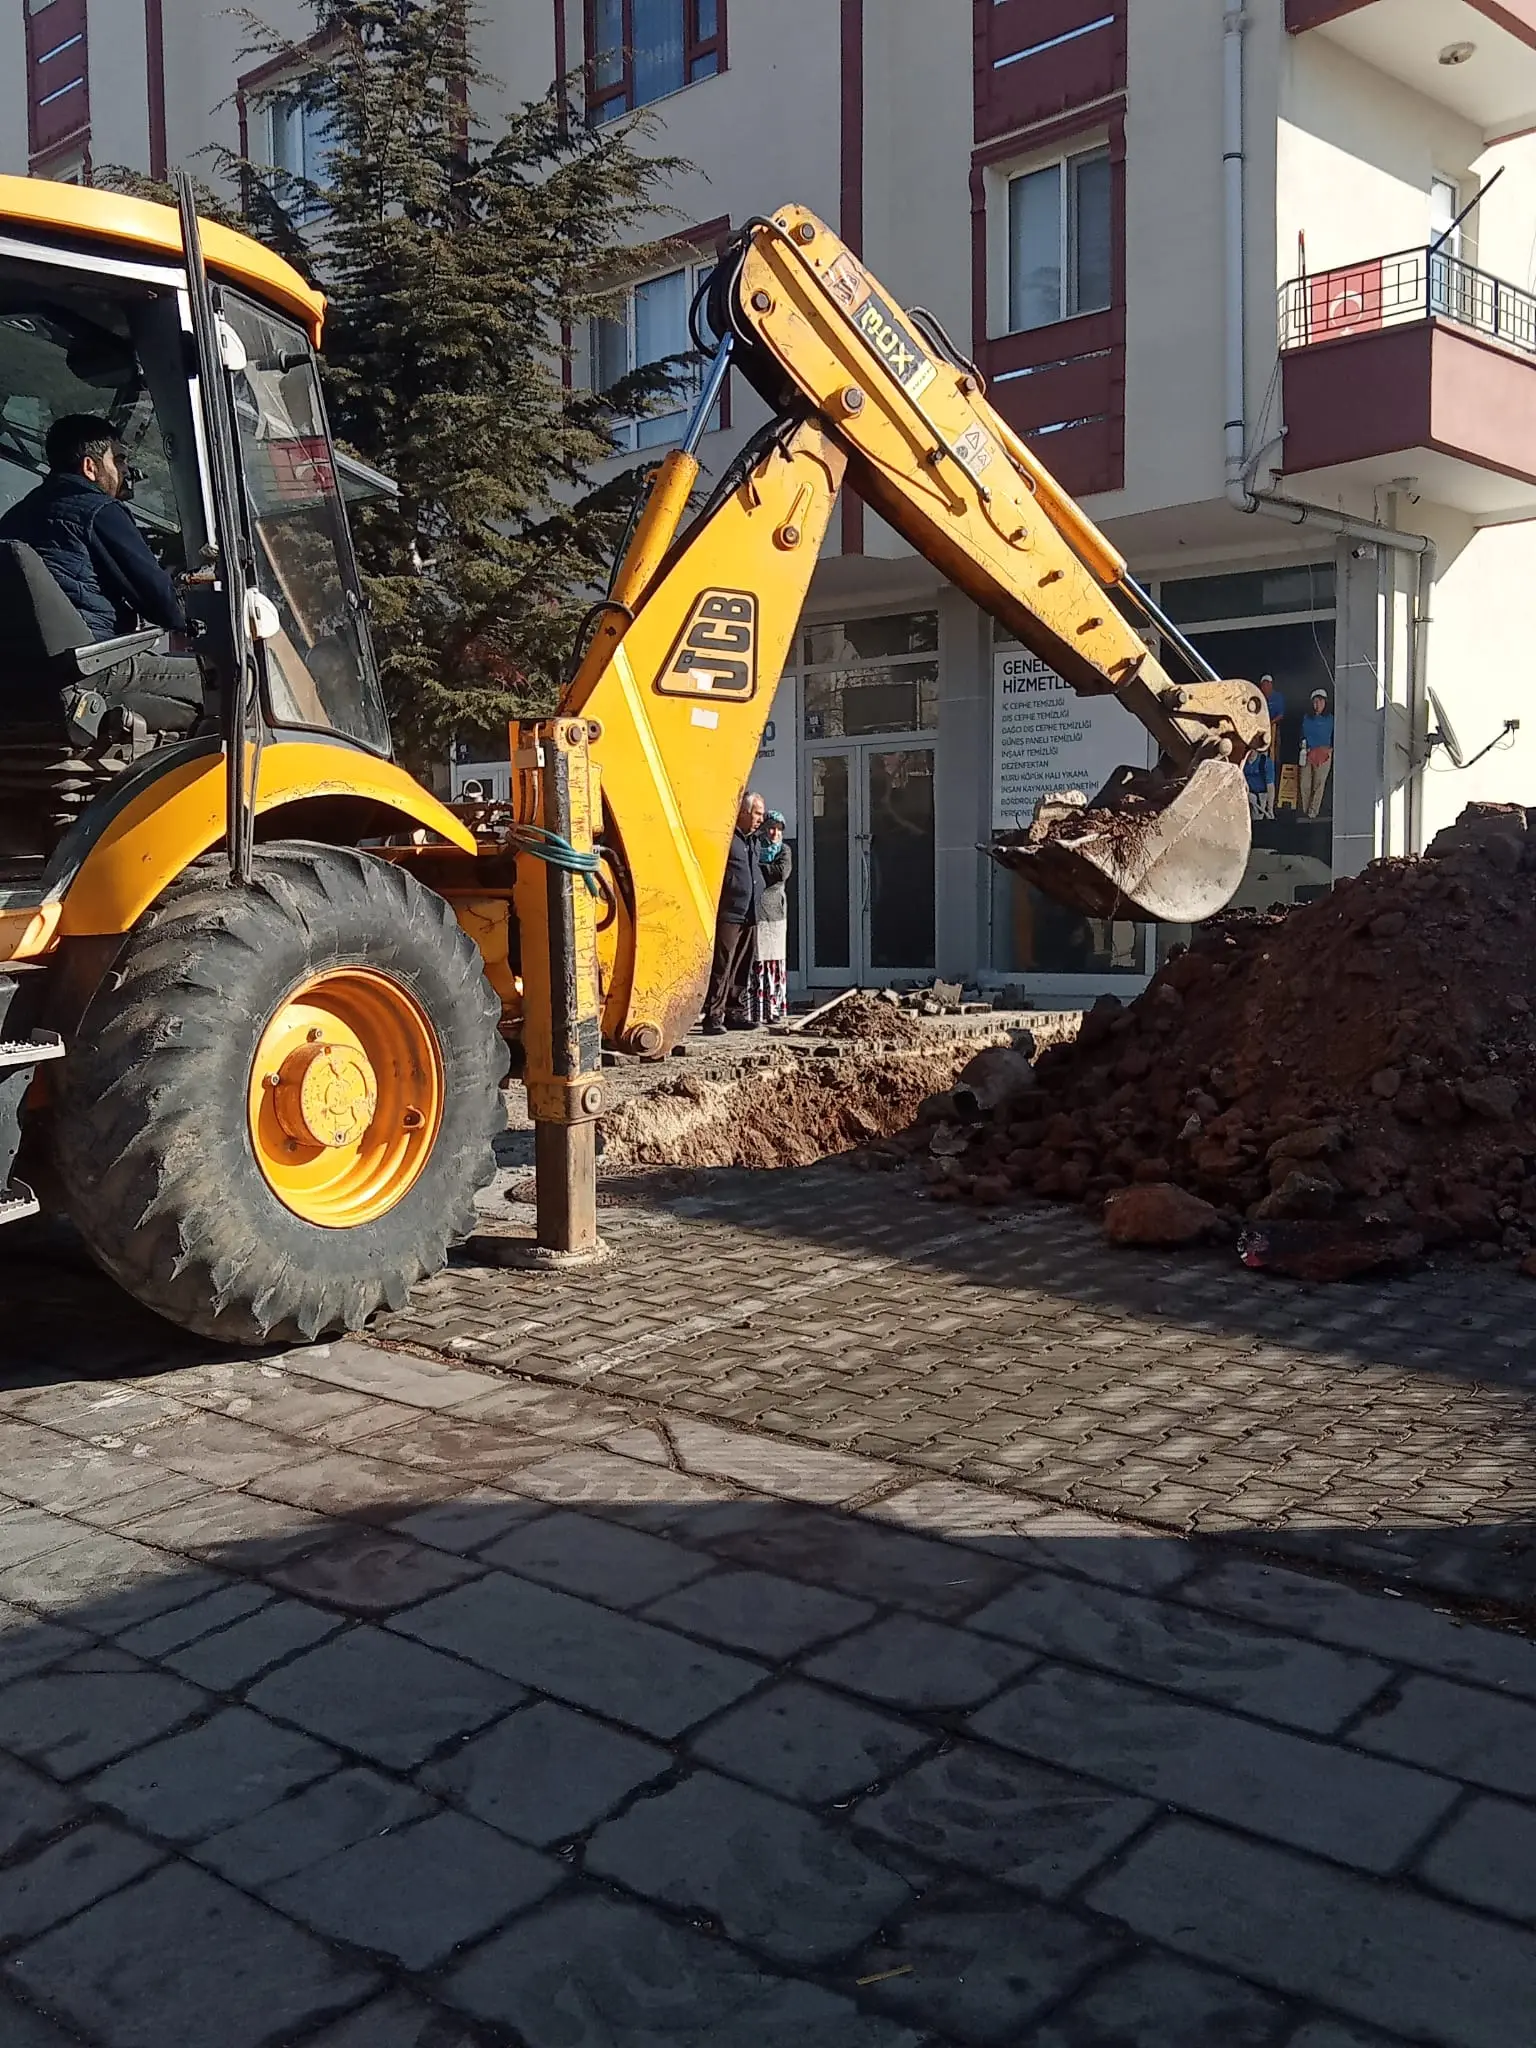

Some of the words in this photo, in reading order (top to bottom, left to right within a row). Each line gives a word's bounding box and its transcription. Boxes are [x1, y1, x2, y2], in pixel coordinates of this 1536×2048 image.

[672, 596, 752, 691] JCB
[1003, 659, 1050, 675] GENEL
[1001, 760, 1049, 770] DEZENFEKTAN
